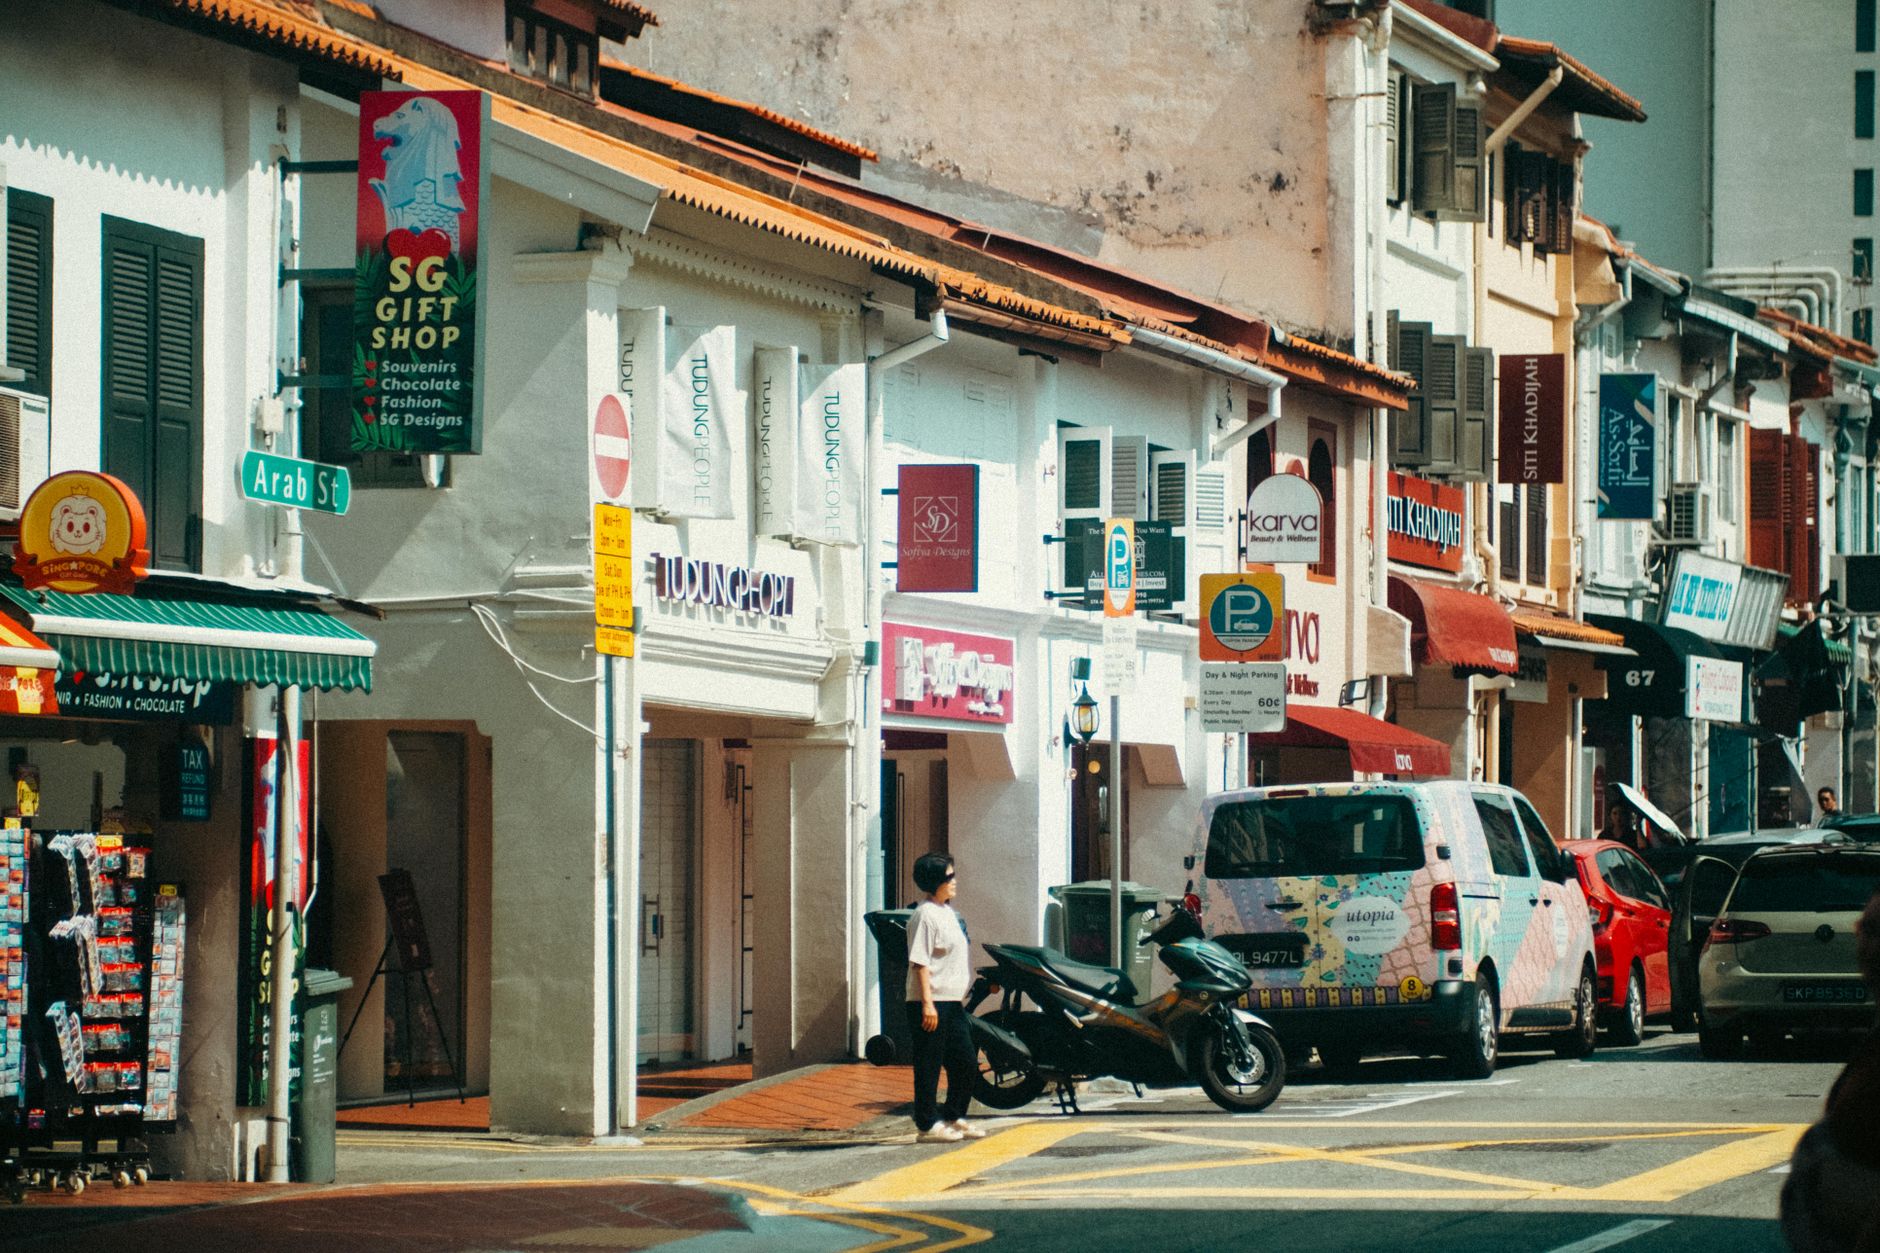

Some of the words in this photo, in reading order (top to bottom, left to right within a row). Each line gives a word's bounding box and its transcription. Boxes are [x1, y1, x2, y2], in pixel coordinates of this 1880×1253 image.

[389, 255, 448, 292] SG
[376, 296, 459, 322] GIFT
[371, 326, 460, 349] SHOP
[382, 360, 457, 373] Souvenirs
[381, 378, 461, 391] Chocolate
[381, 395, 442, 409] Fashion
[1523, 358, 1541, 444] KHADIJAH
[380, 413, 400, 426] SG
[404, 413, 463, 429] Designs
[1523, 450, 1538, 480] SITI
[254, 459, 307, 501] Arab
[317, 471, 339, 508] St
[1249, 510, 1318, 532] karva
[1406, 496, 1461, 554] KHADIJAH
[1251, 535, 1276, 543] Beauty
[1276, 534, 1284, 542] &
[1287, 534, 1317, 542] Wellness
[1205, 671, 1219, 680] Day
[1222, 671, 1227, 679] &
[1230, 671, 1249, 680] Night
[1251, 671, 1279, 680] Parking
[1625, 670, 1656, 687] 67
[83, 693, 123, 709] FASHION
[134, 697, 185, 714] CHOCOLATE
[1258, 697, 1280, 707] 60¢
[182, 749, 204, 770] TAX
[181, 772, 205, 785] REFUND
[1346, 906, 1395, 926] utopia
[1252, 950, 1299, 964] 9477L
[1408, 979, 1415, 991] 8
